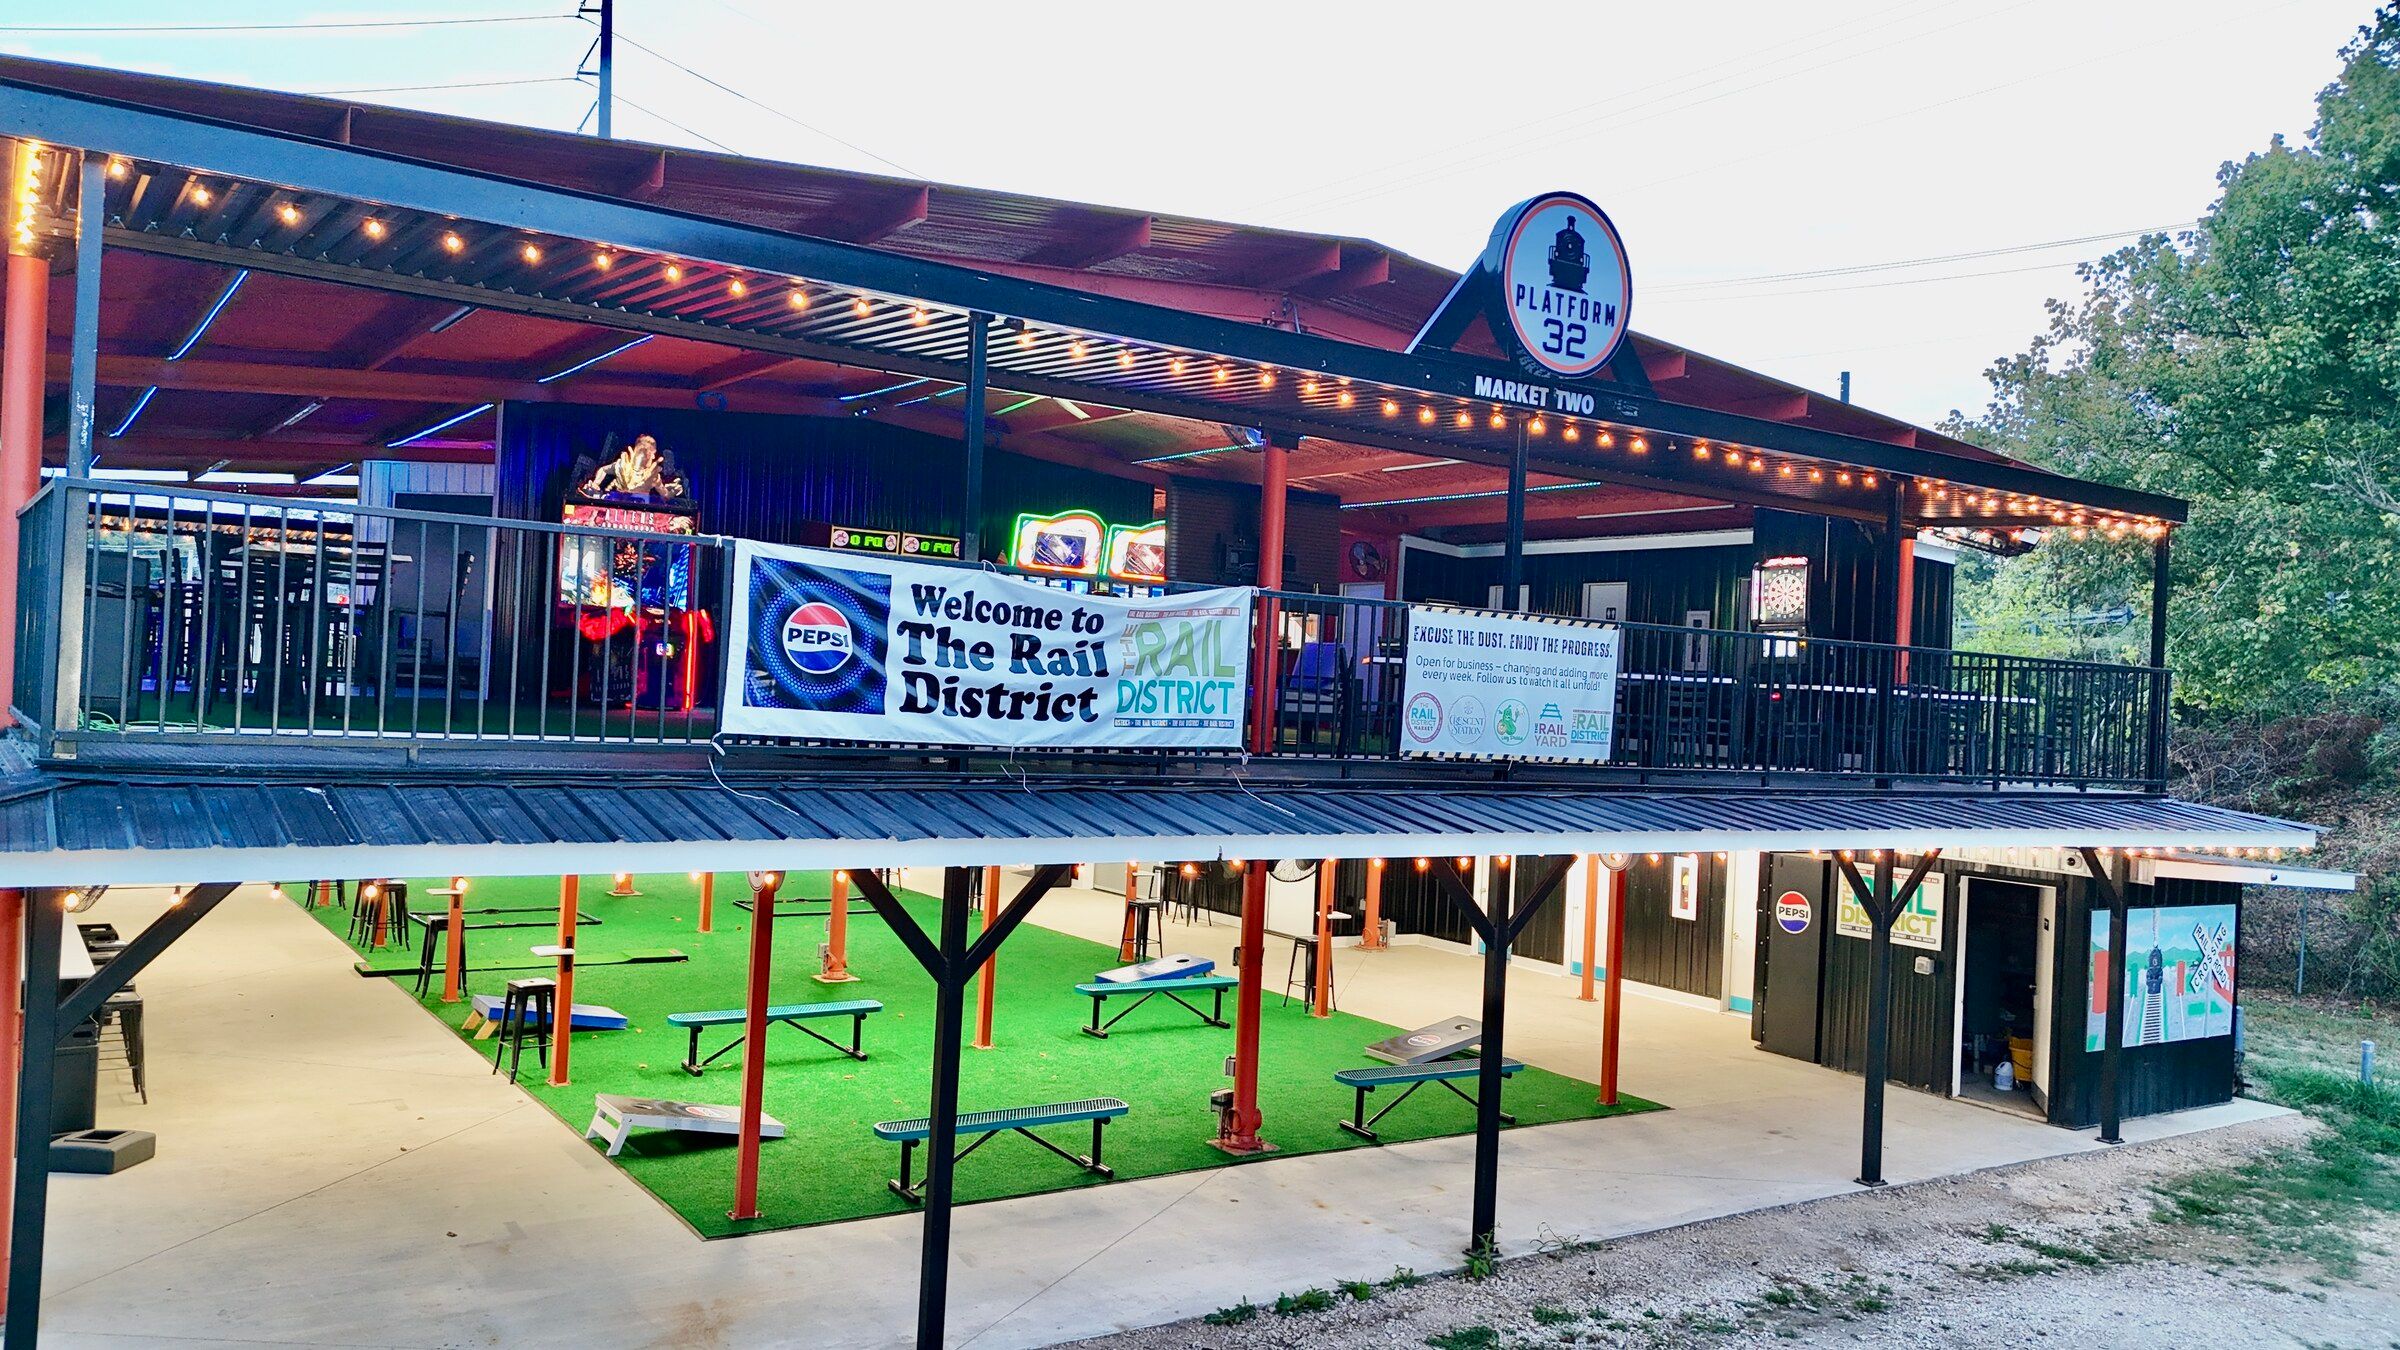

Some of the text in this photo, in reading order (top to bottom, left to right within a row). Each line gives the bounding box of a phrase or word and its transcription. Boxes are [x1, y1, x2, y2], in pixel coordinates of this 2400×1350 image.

[1516, 284, 1616, 327] PLATFORM
[1542, 317, 1587, 359] 32
[1474, 375, 1549, 407] MARKET
[1555, 389, 1595, 415] TWO
[911, 583, 1104, 635] Welcome to
[787, 627, 850, 648] PEPSI
[896, 620, 1110, 678] The Rail
[1119, 624, 1138, 677] THE
[1134, 619, 1236, 678] RAIL
[1413, 625, 1613, 658] EXCUSE THE DUST. ENJOY THE PROGRESS.
[1415, 655, 1441, 668] Open
[1443, 656, 1455, 668] for
[1457, 658, 1494, 671] business
[1503, 662, 1540, 677] changing
[1542, 666, 1558, 676] and
[1559, 667, 1588, 680] adding
[1589, 671, 1609, 680] more
[1422, 670, 1600, 691] every week. Follow us to watch it all unfold!
[899, 670, 1099, 723] District
[1116, 679, 1235, 715] DISTRICT
[1411, 707, 1436, 720] RAIL
[1539, 723, 1567, 736] RAIL
[1570, 730, 1609, 741] DISTRICT
[1576, 713, 1610, 731] RAIL
[1535, 735, 1568, 748] YARD
[1778, 906, 1809, 919] PEPSI
[2194, 926, 2227, 987] CROSSING
[2196, 926, 2227, 983] RAIL ROAD
